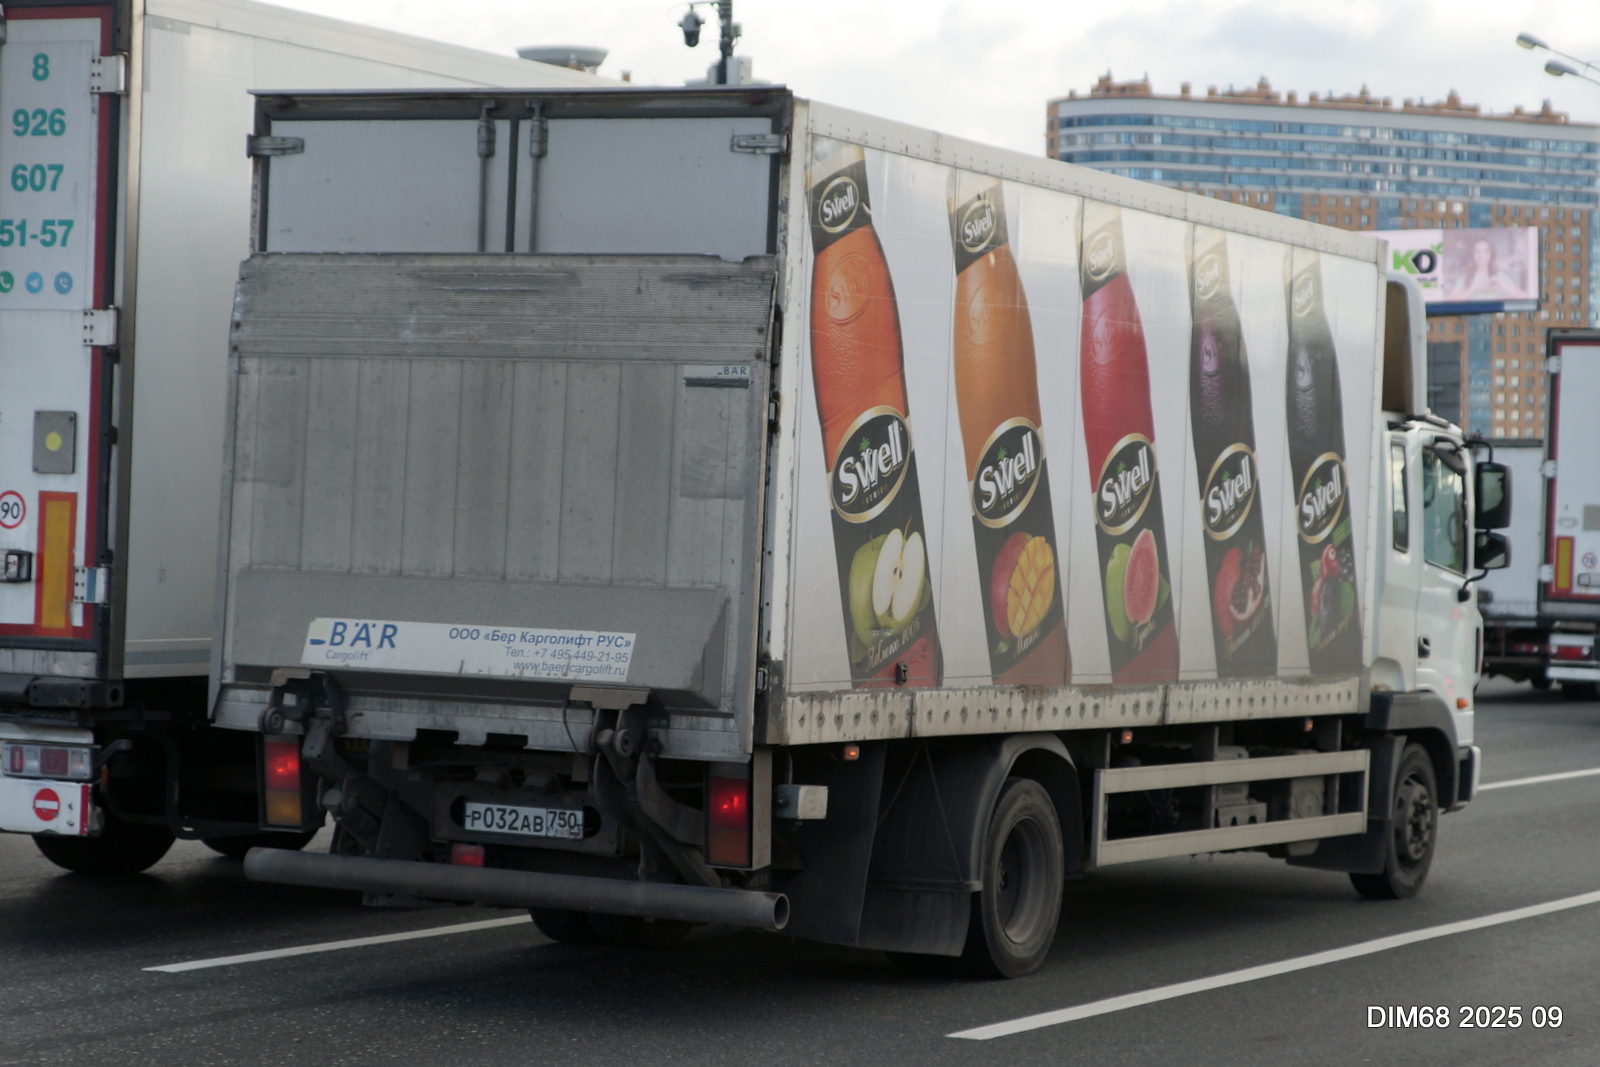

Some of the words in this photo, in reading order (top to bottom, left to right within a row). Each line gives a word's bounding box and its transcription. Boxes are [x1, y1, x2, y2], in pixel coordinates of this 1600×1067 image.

[31, 53, 50, 81] 8
[12, 108, 66, 136] 926
[10, 163, 64, 192] 607
[822, 185, 855, 222] Swell
[0, 219, 74, 247] 51-57
[963, 207, 993, 243] Swell
[838, 418, 903, 503] Swell
[979, 430, 1036, 509] Swell
[1101, 445, 1150, 519] Swell
[1207, 455, 1252, 524] Swell
[1301, 463, 1342, 529] Swell
[1, 501, 20, 519] 90
[329, 621, 398, 649] BÄR
[483, 630, 516, 643] «Бер
[519, 631, 593, 648] Карголифт
[596, 635, 631, 648] РУС»
[325, 649, 369, 662] Cargolift
[534, 648, 548, 658] +7
[550, 649, 571, 660] 495
[573, 650, 629, 663] 449-21-95
